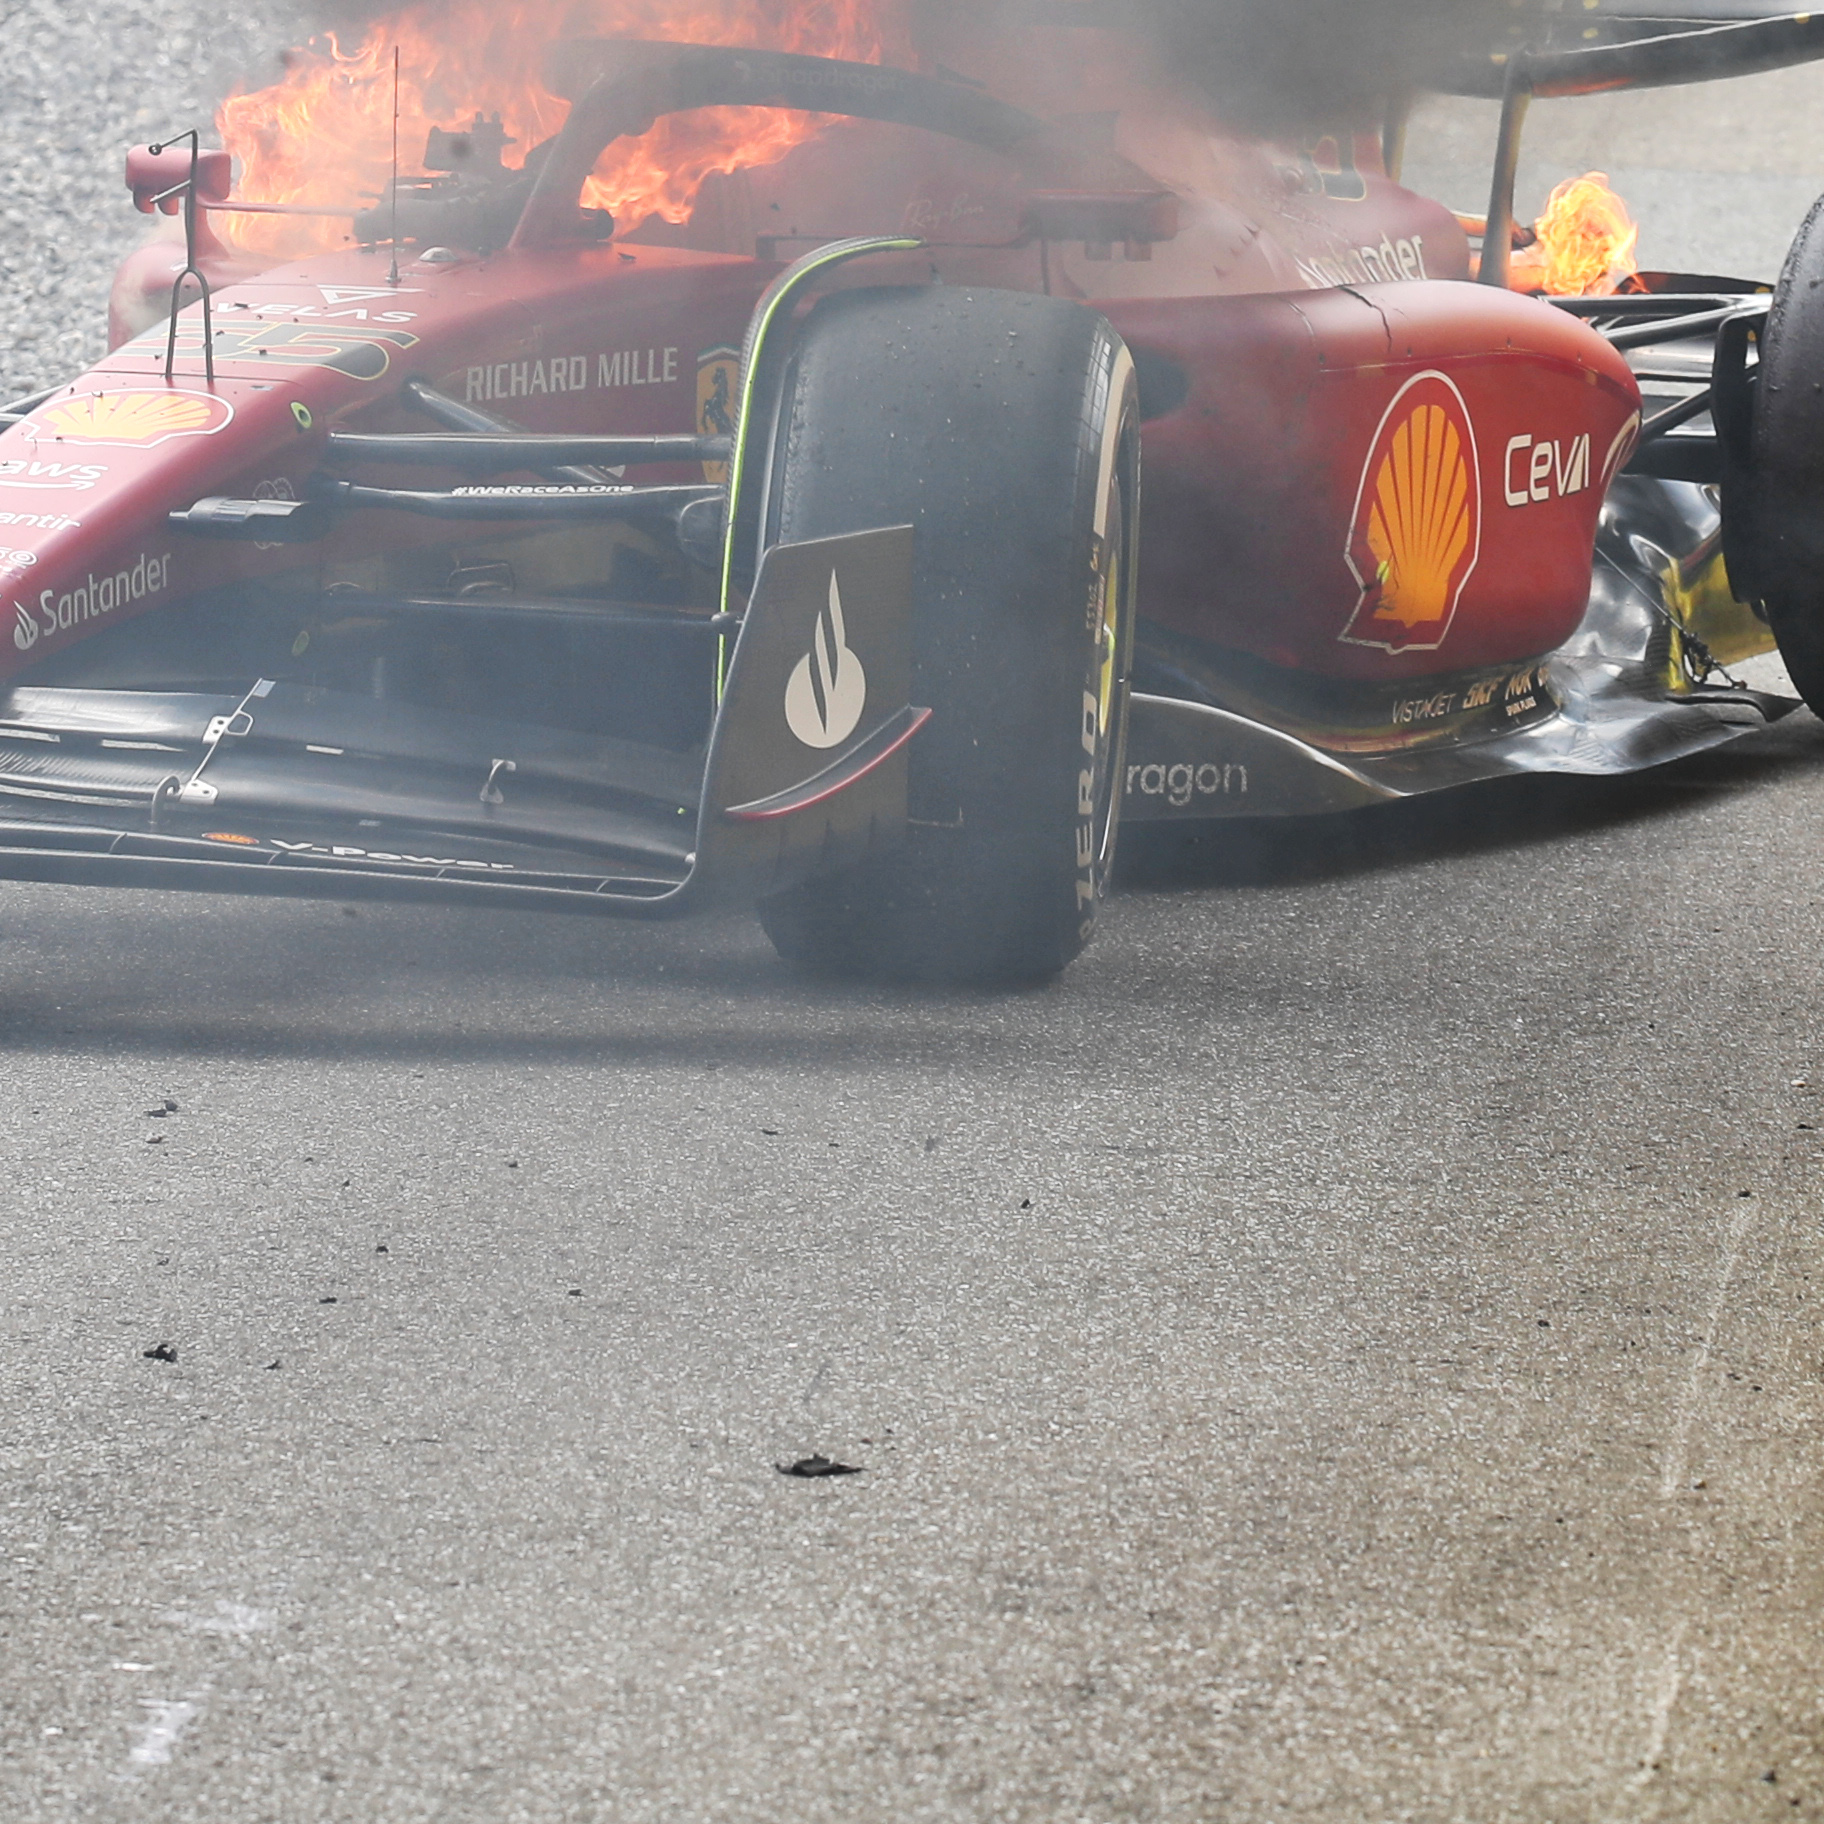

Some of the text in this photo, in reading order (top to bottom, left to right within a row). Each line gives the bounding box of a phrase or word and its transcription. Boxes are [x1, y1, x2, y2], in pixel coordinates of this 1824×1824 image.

[214, 301, 418, 323] VELAS
[465, 346, 679, 403] RICHARD MILLE
[451, 484, 634, 496] #WeRaceAsOne
[40, 552, 172, 638] Santander
